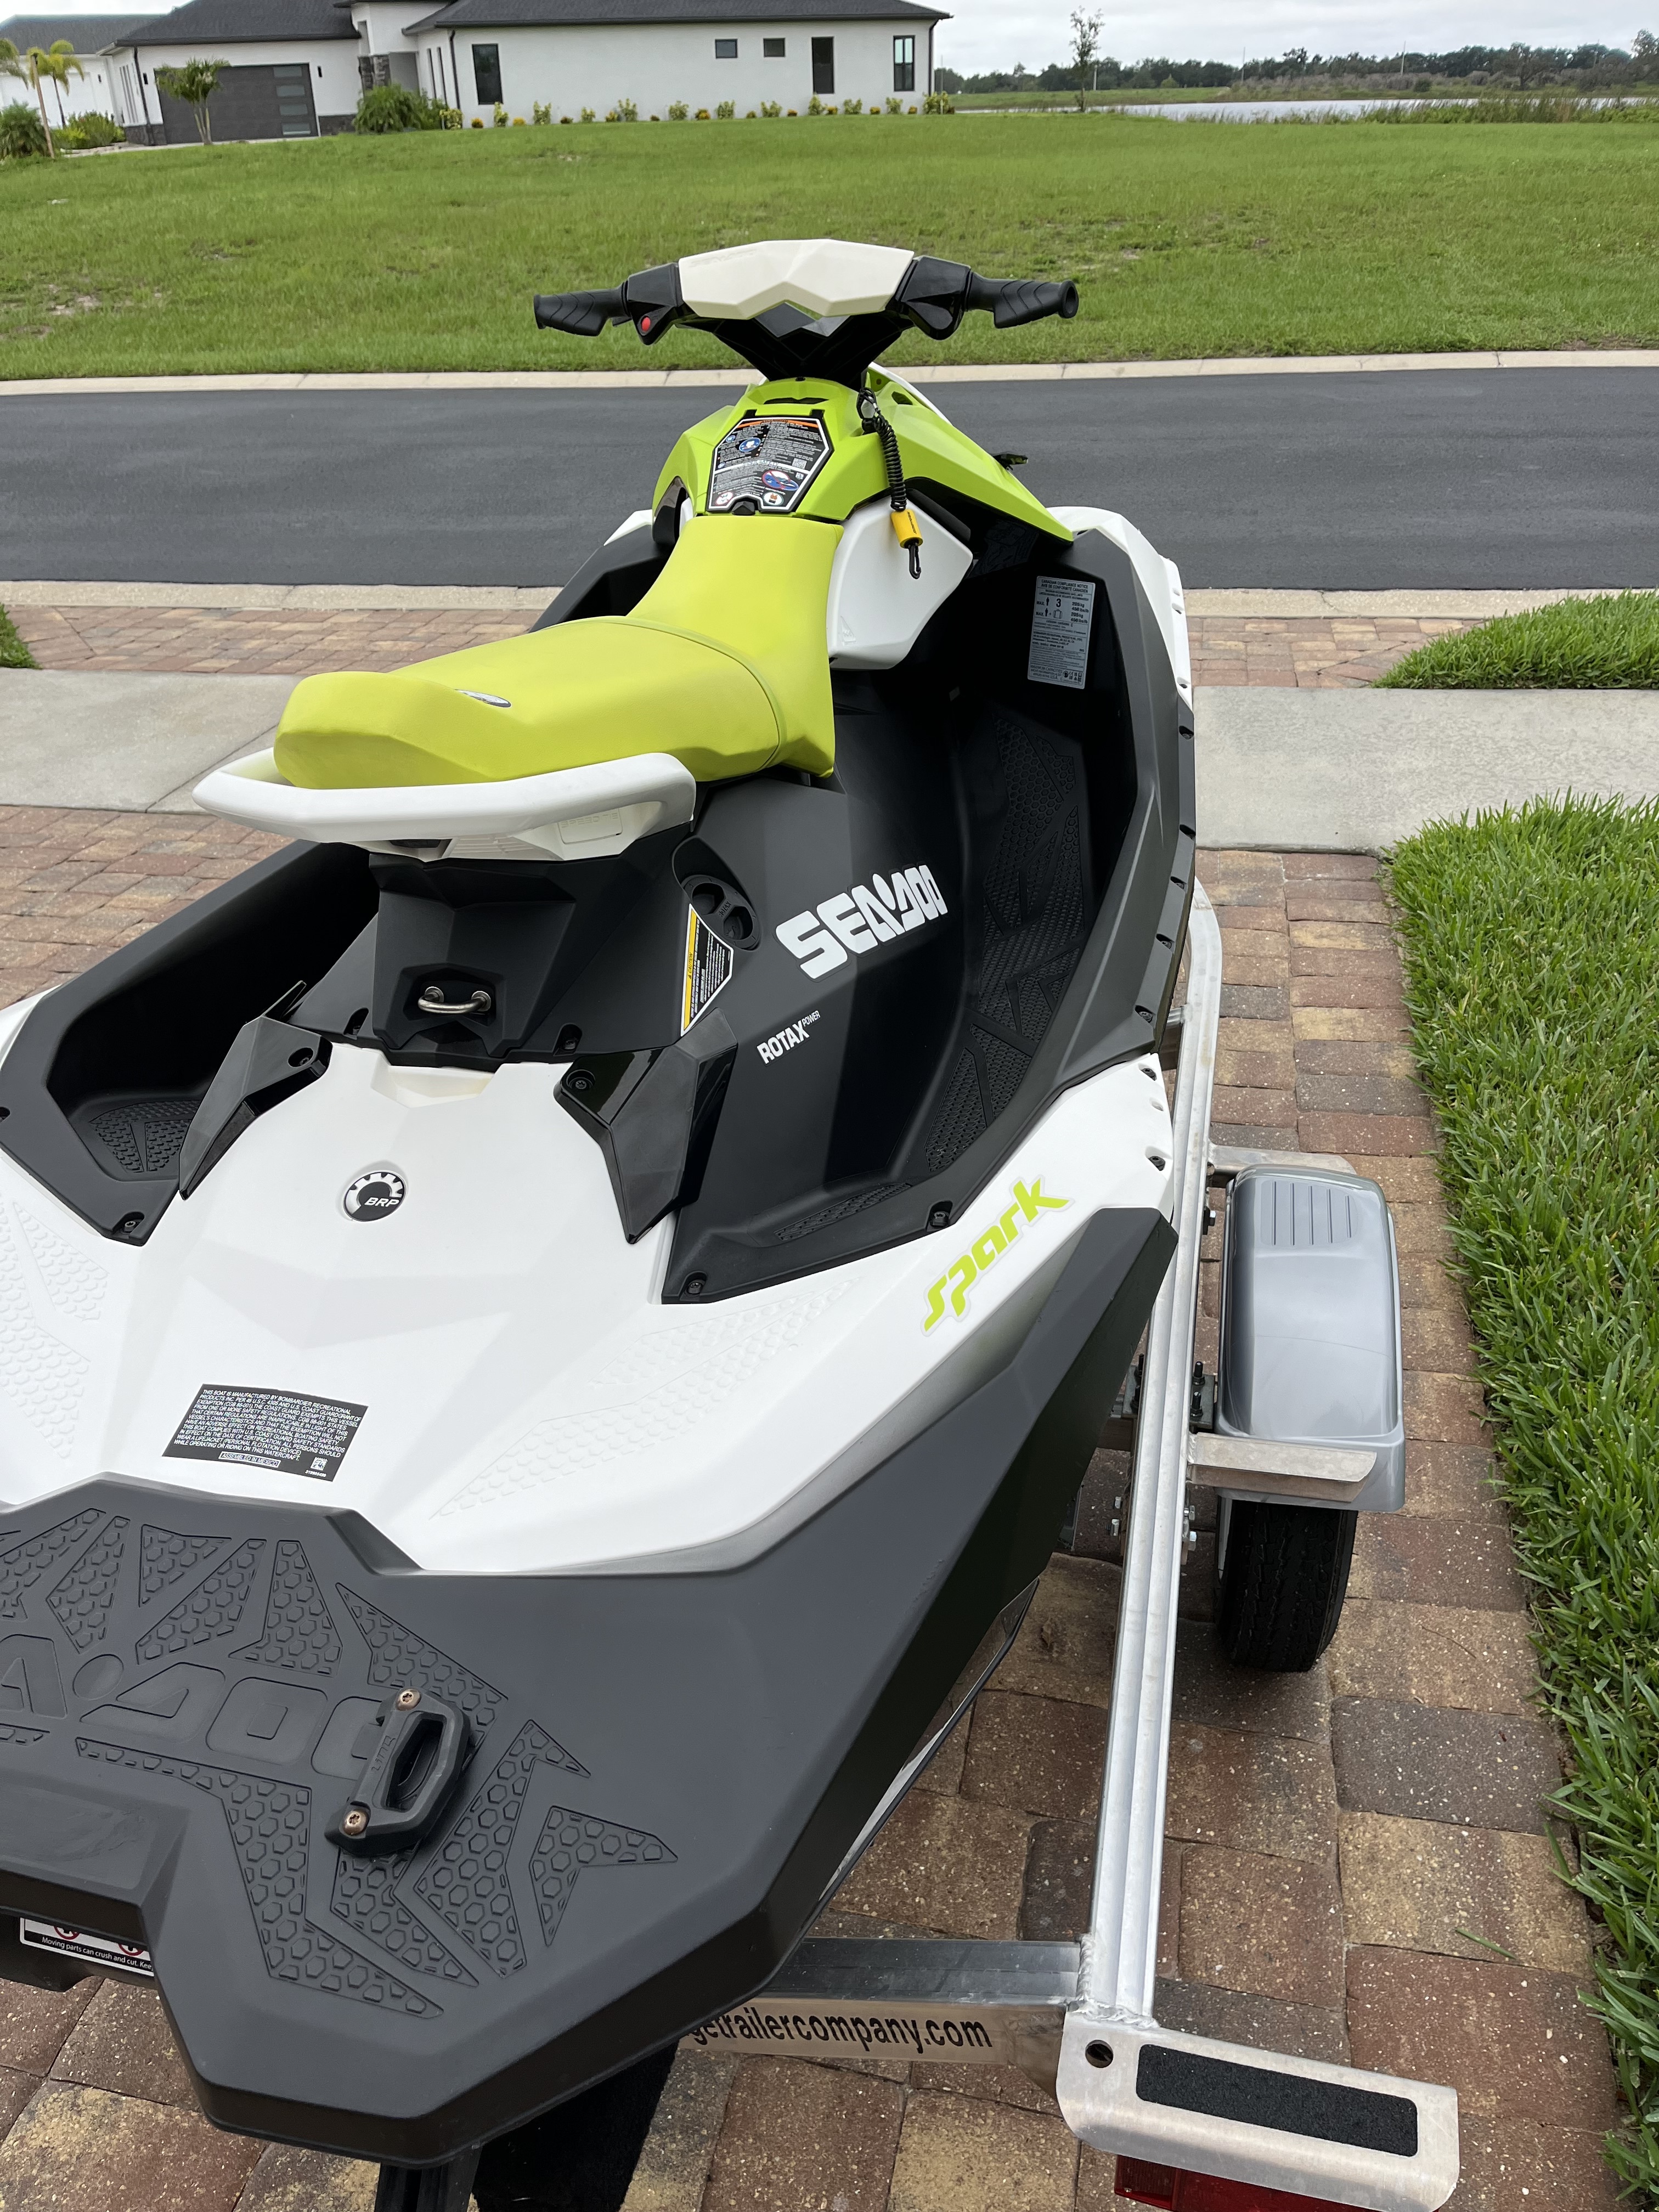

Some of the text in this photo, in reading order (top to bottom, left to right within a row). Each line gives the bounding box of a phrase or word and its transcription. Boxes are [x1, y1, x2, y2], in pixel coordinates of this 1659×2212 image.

[1056, 597, 1062, 607] 3
[757, 1010, 821, 1064] ROTAX POWER
[364, 1197, 399, 1207] BRP
[278, 1396, 312, 1406] BOMBARDIER
[312, 1403, 351, 1414] RECREATIONAL
[268, 1417, 304, 1427] INAPPLICABLE
[300, 1411, 325, 1420] EXEMPTS
[338, 1419, 358, 1427] VESSEL
[211, 1416, 255, 1424] CHARACTERISTICS
[290, 1426, 321, 1436] EXEMPTION
[327, 1422, 347, 1430] STATES
[255, 1425, 293, 1436] RECREATIONAL
[294, 1432, 318, 1441] BOATING
[318, 1437, 339, 1446] SAFETY.
[251, 1441, 280, 1451] FLOTATION
[292, 1444, 319, 1453] PERSONS
[319, 1449, 341, 1457] SHOULD
[313, 1442, 345, 1453] STANDARDS
[264, 1449, 300, 1460] WATERCRAFT.
[42, 1937, 65, 1949] Moving
[66, 1943, 82, 1952] parts
[95, 1951, 112, 1960] crush
[114, 1955, 126, 1963] and
[686, 2007, 992, 2053] getrailercompany.com
